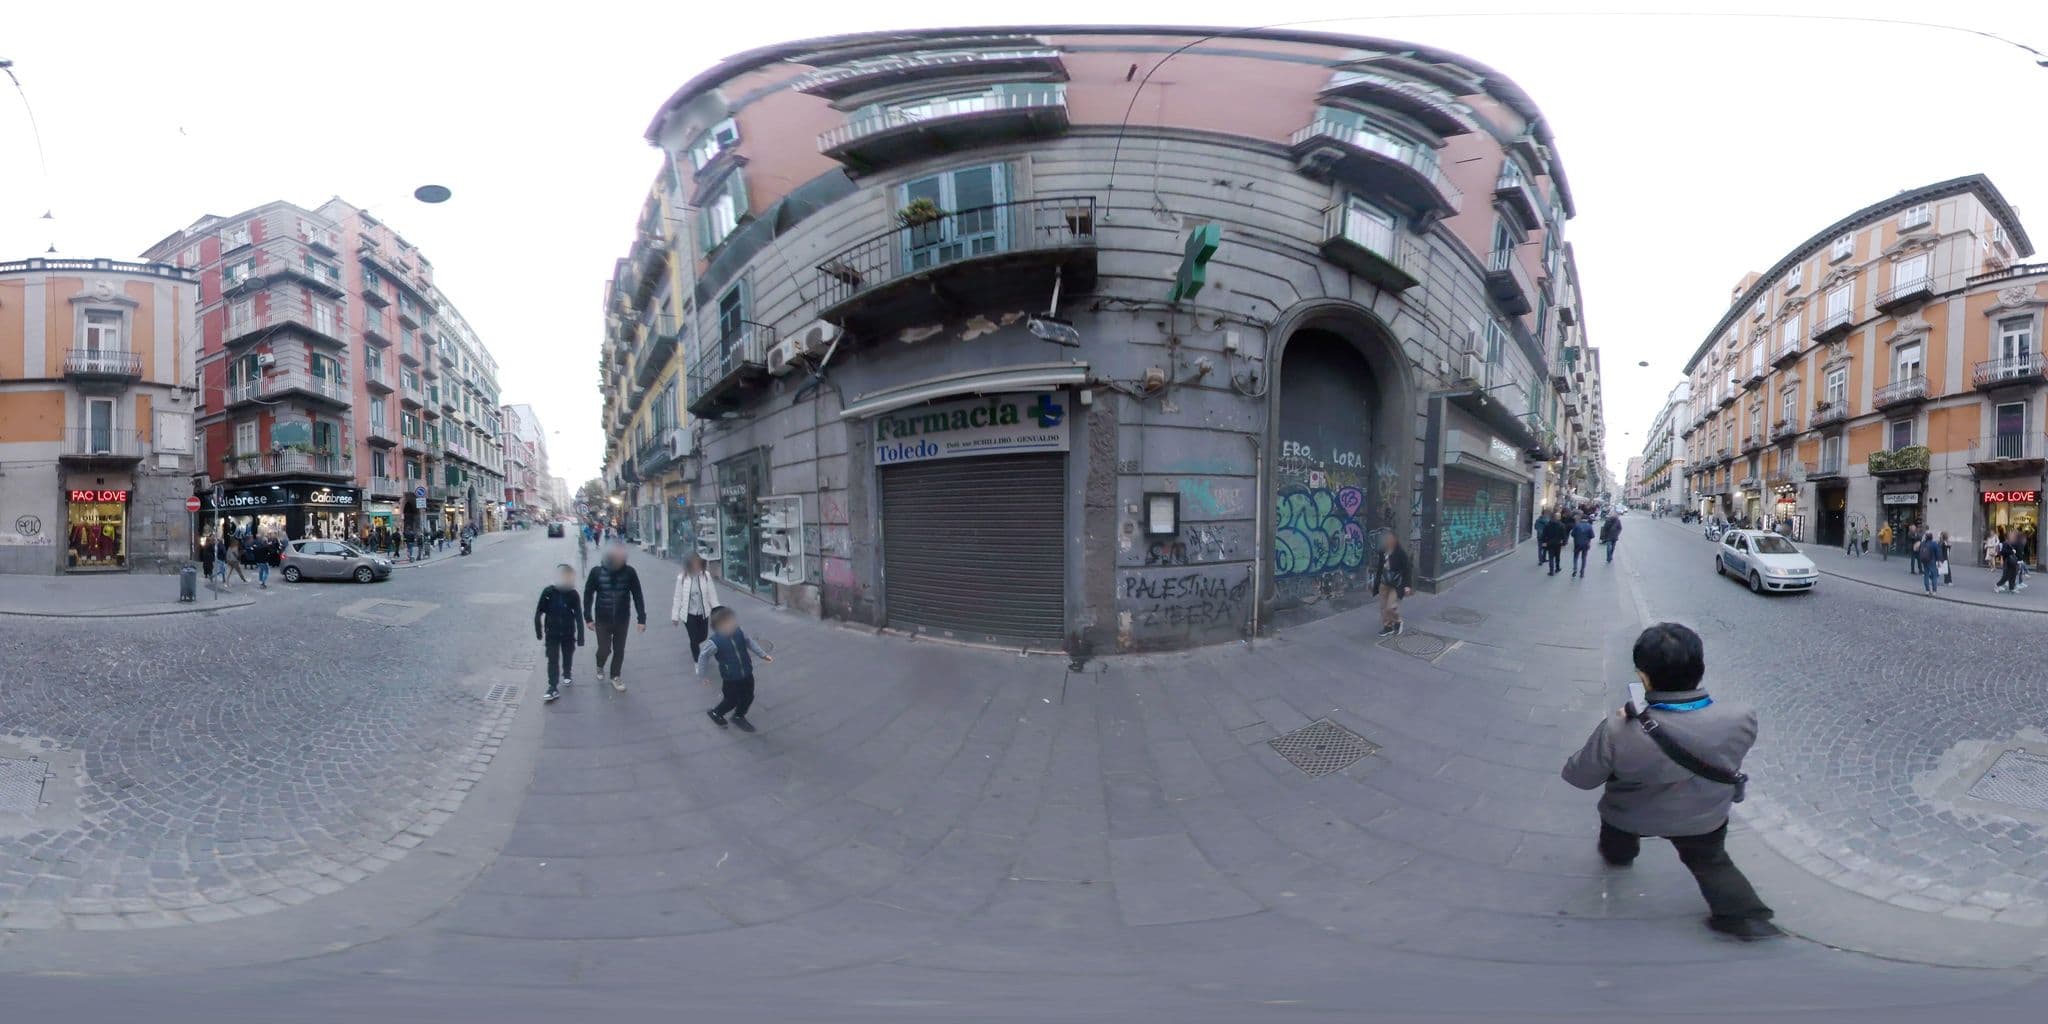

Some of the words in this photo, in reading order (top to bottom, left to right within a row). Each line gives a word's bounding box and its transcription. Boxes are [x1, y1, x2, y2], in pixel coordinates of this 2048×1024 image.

[876, 399, 1019, 441] Farmacia
[1017, 434, 1060, 443] GENUALDO
[877, 440, 939, 461] Toledo
[97, 490, 127, 501] LOVE
[310, 491, 353, 504] Calabrese
[2007, 491, 2034, 501] LOVE
[1126, 574, 1228, 599] PALESTINA
[1143, 601, 1231, 626] LIBERA
